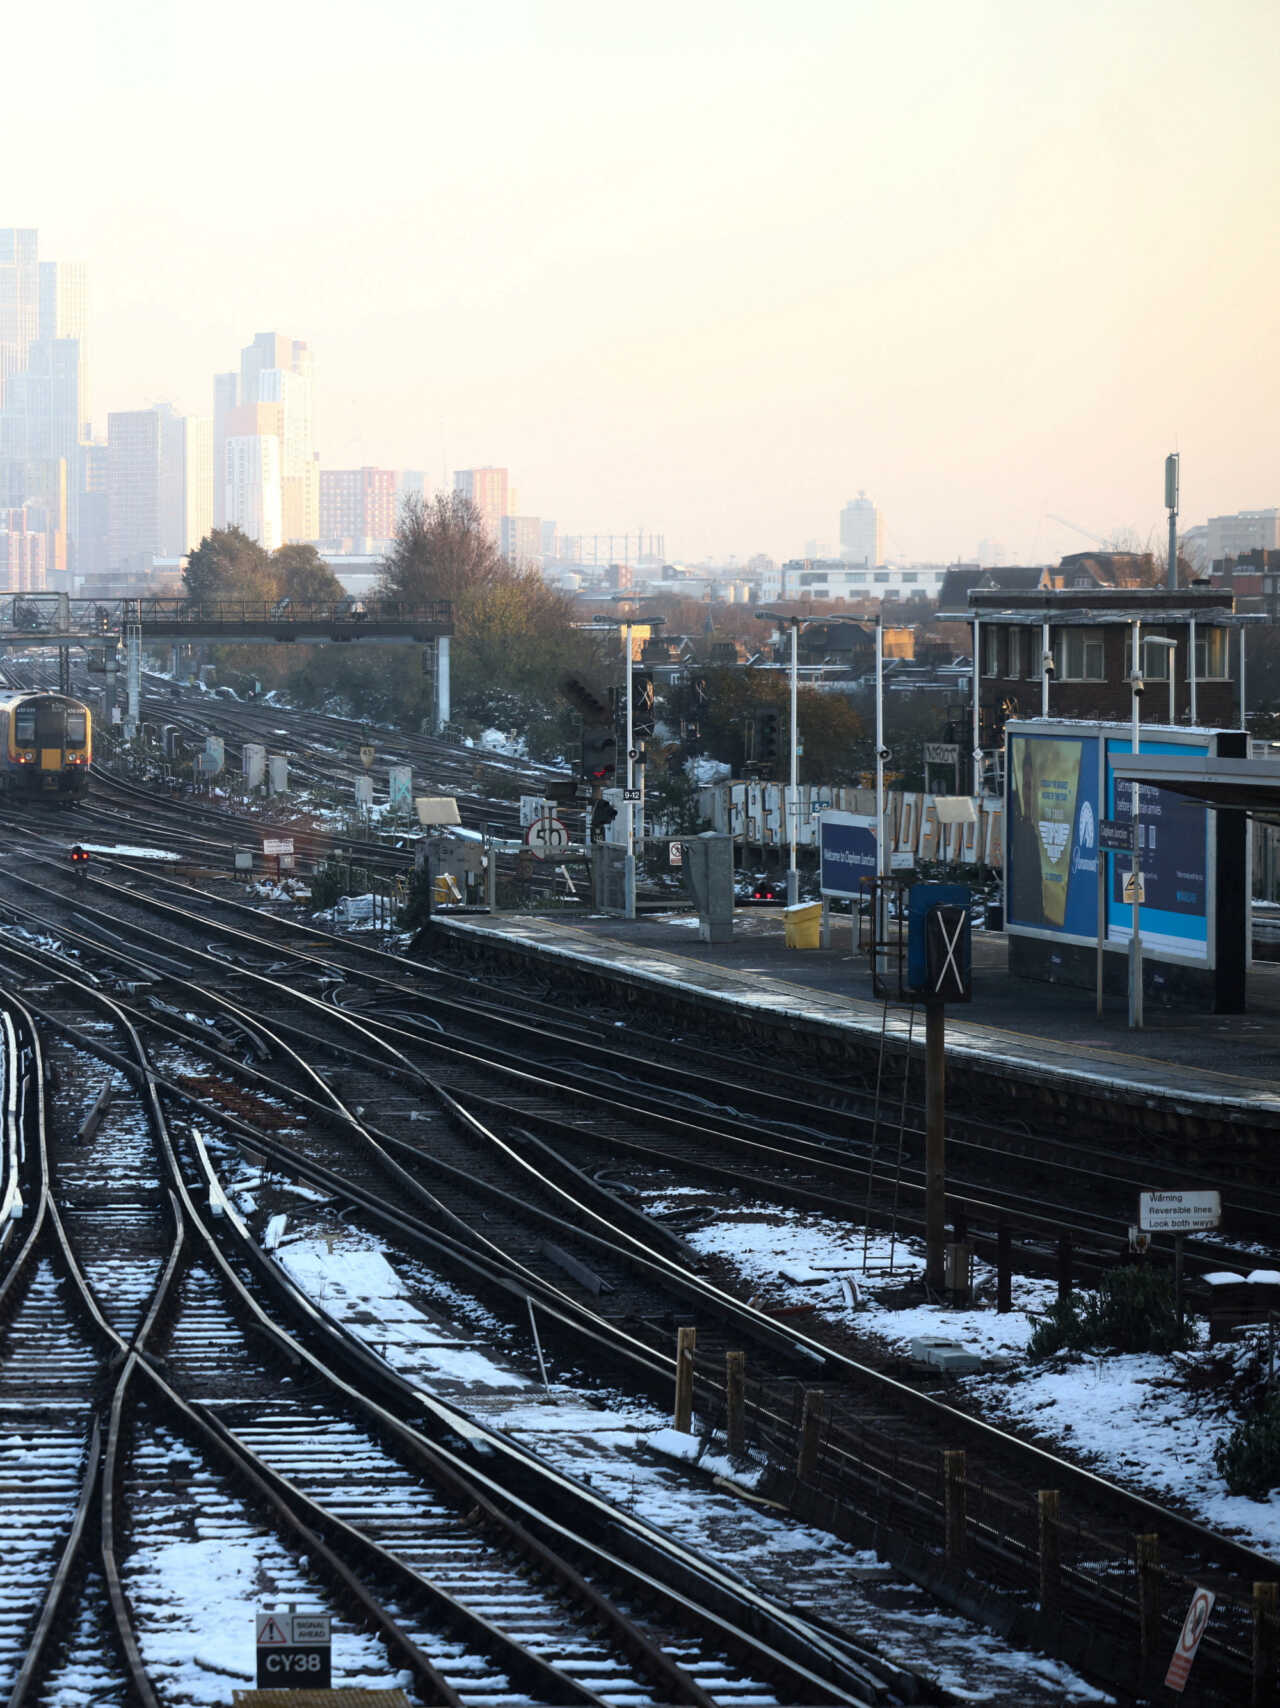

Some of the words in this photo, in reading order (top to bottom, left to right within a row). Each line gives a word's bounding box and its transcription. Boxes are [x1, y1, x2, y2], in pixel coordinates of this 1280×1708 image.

[624, 791, 640, 799] 9-12
[536, 828, 562, 848] 50
[1149, 1193, 1183, 1203] Warning
[1149, 1206, 1191, 1215] Reversible
[1193, 1206, 1212, 1214] lines
[1149, 1218, 1169, 1228] Look
[1171, 1218, 1190, 1228] both
[1192, 1219, 1214, 1229] ways
[296, 1621, 325, 1629] SIGNAL
[298, 1630, 325, 1638] AHEAD
[266, 1653, 321, 1672] CY38
